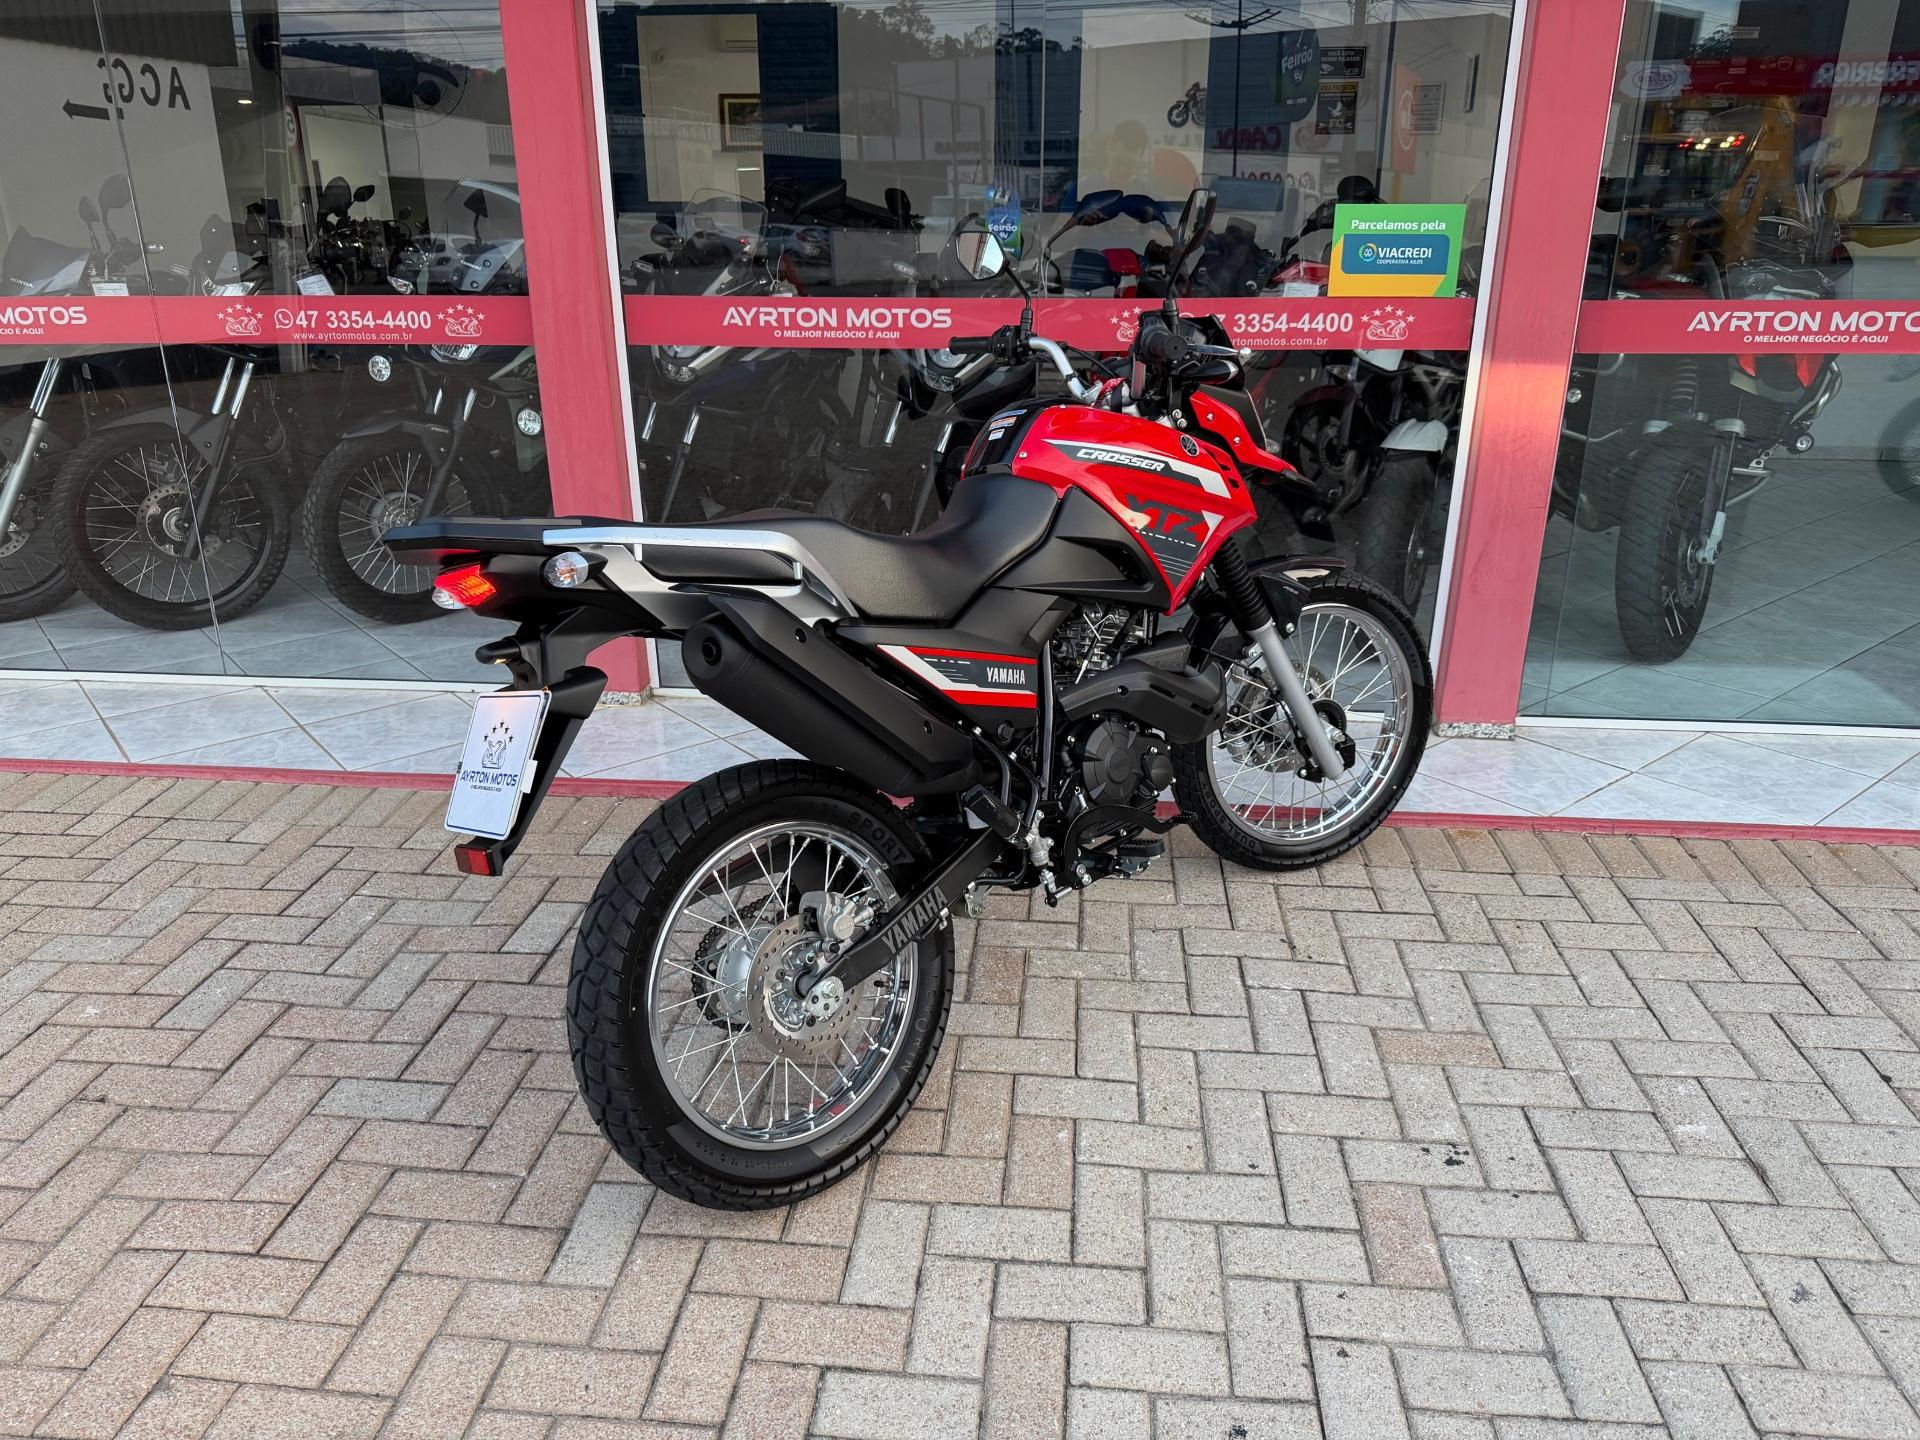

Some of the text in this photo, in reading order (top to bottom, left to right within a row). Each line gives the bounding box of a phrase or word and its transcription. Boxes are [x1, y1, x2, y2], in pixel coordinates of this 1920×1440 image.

[1281, 45, 1313, 75] Feirão
[988, 223, 1018, 232] Feirão
[1351, 219, 1446, 232] Parcelamos pela
[1378, 247, 1432, 258] VIACREDI
[0, 306, 88, 325] MOTOS
[295, 310, 432, 329] 47 3354-4400
[722, 306, 953, 329] AYRTON MOTOS
[1233, 313, 1353, 333] 3354-4400
[1687, 311, 1822, 332] AYRTON
[293, 332, 414, 342] www.ayrtonmotos.com.br
[774, 328, 900, 339] O MELHOR NEGÓCIO É AQUI
[1232, 336, 1328, 346] rtonmotos.com.br
[1743, 333, 1889, 343] O MELHOR NEGÓCIO É AQUI
[1076, 447, 1167, 472] CROSSER
[986, 667, 1027, 685] YAMAHA
[460, 771, 518, 786] AYRTON MOTOS
[848, 810, 907, 862] SPORT
[881, 885, 948, 954] YAMAHA
